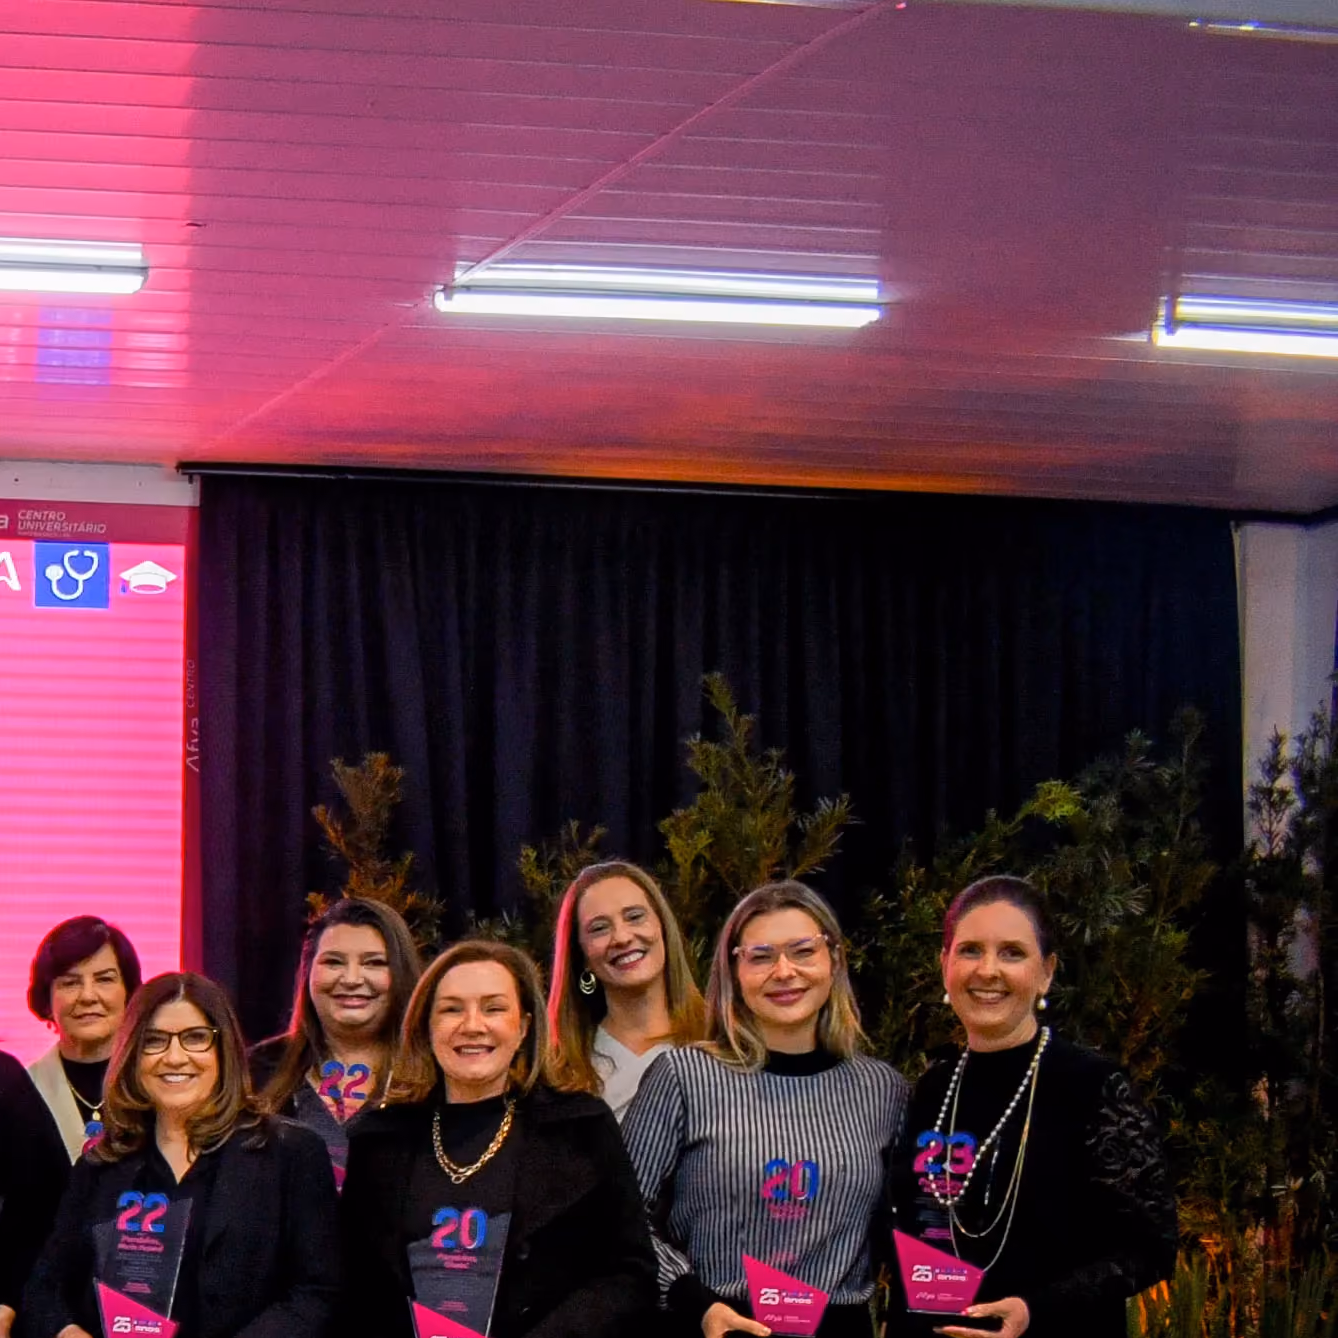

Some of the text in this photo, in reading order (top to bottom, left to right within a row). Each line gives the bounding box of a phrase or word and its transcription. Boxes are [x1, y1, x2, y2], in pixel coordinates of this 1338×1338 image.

[18, 510, 66, 521] CENTRO
[318, 1060, 370, 1099] 22
[912, 1130, 978, 1174] 23
[760, 1158, 819, 1201] 20
[116, 1191, 169, 1232] 22
[432, 1207, 488, 1249] 20
